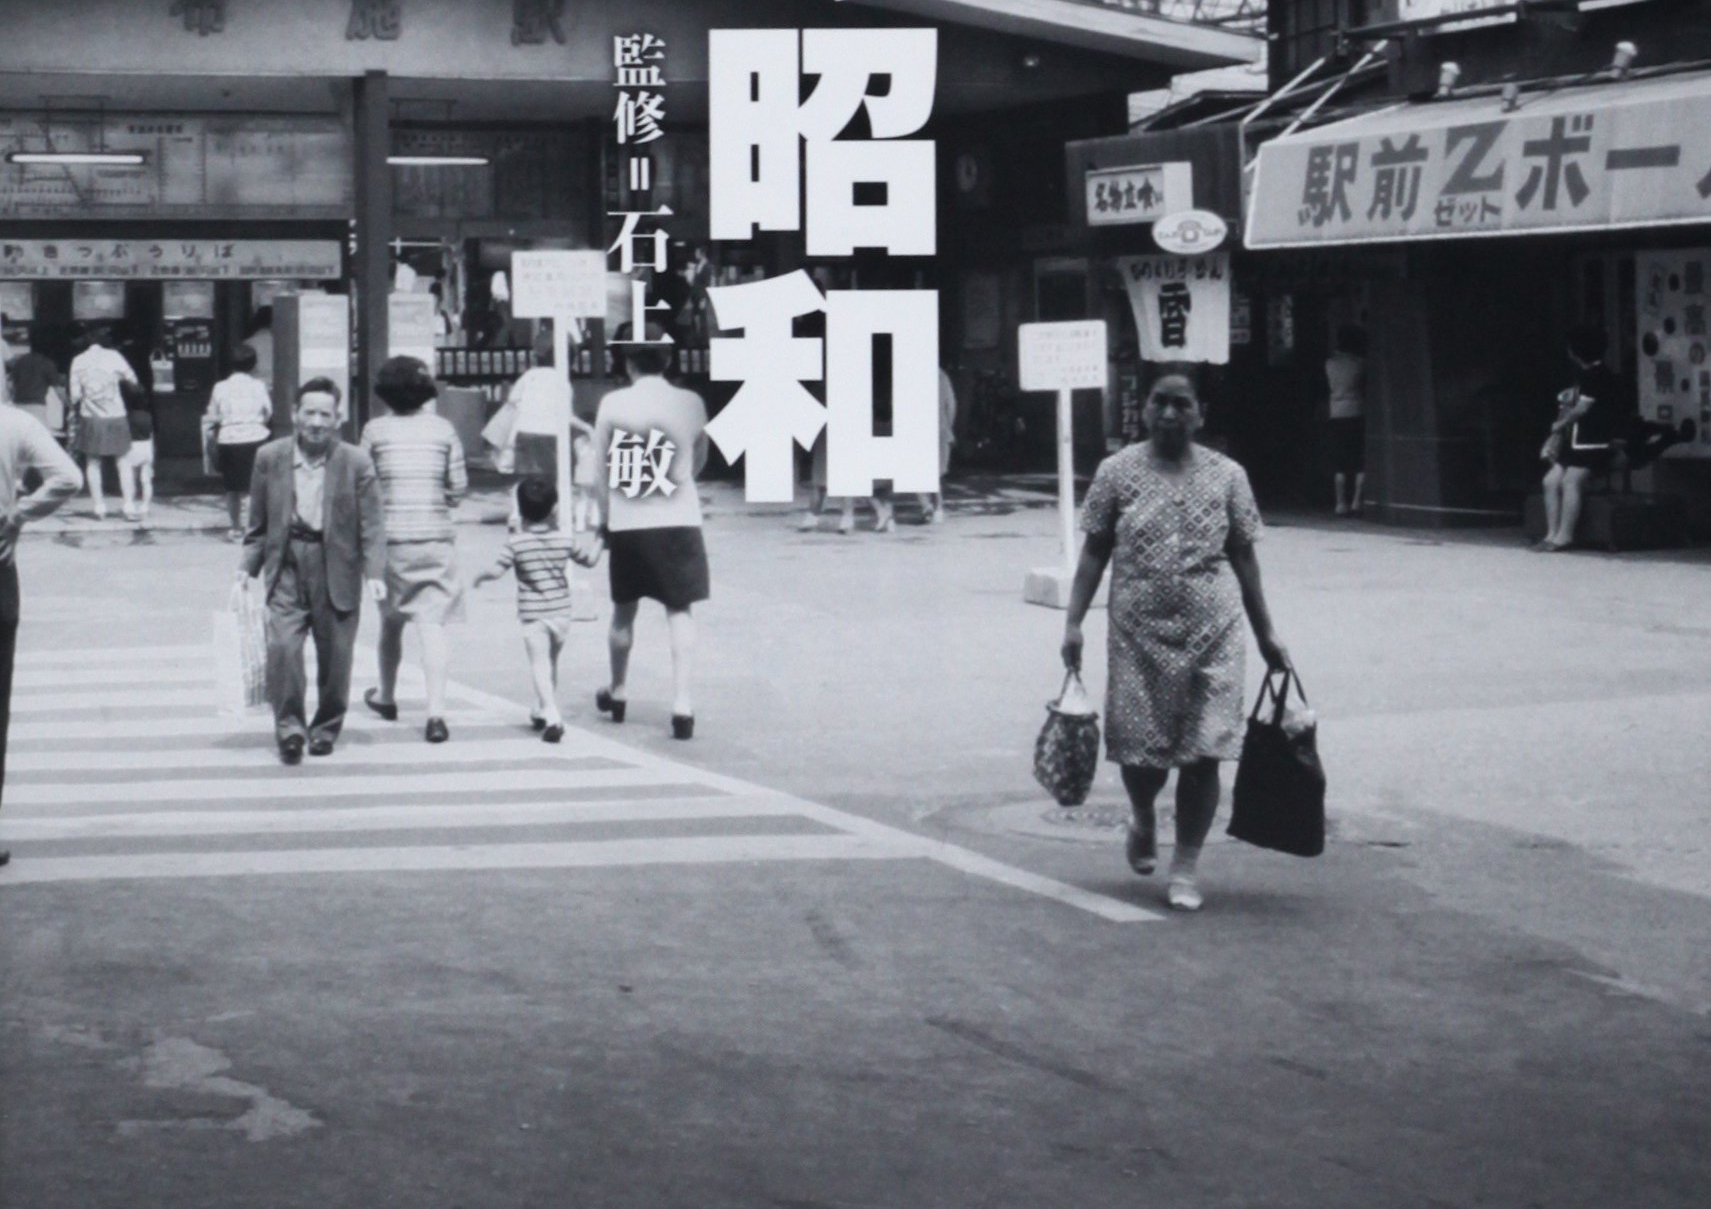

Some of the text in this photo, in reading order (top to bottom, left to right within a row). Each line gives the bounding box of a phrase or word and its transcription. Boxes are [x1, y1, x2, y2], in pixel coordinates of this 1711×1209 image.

[1298, 114, 1711, 228] 駅前Zボー
[1434, 195, 1501, 227] ゼット
